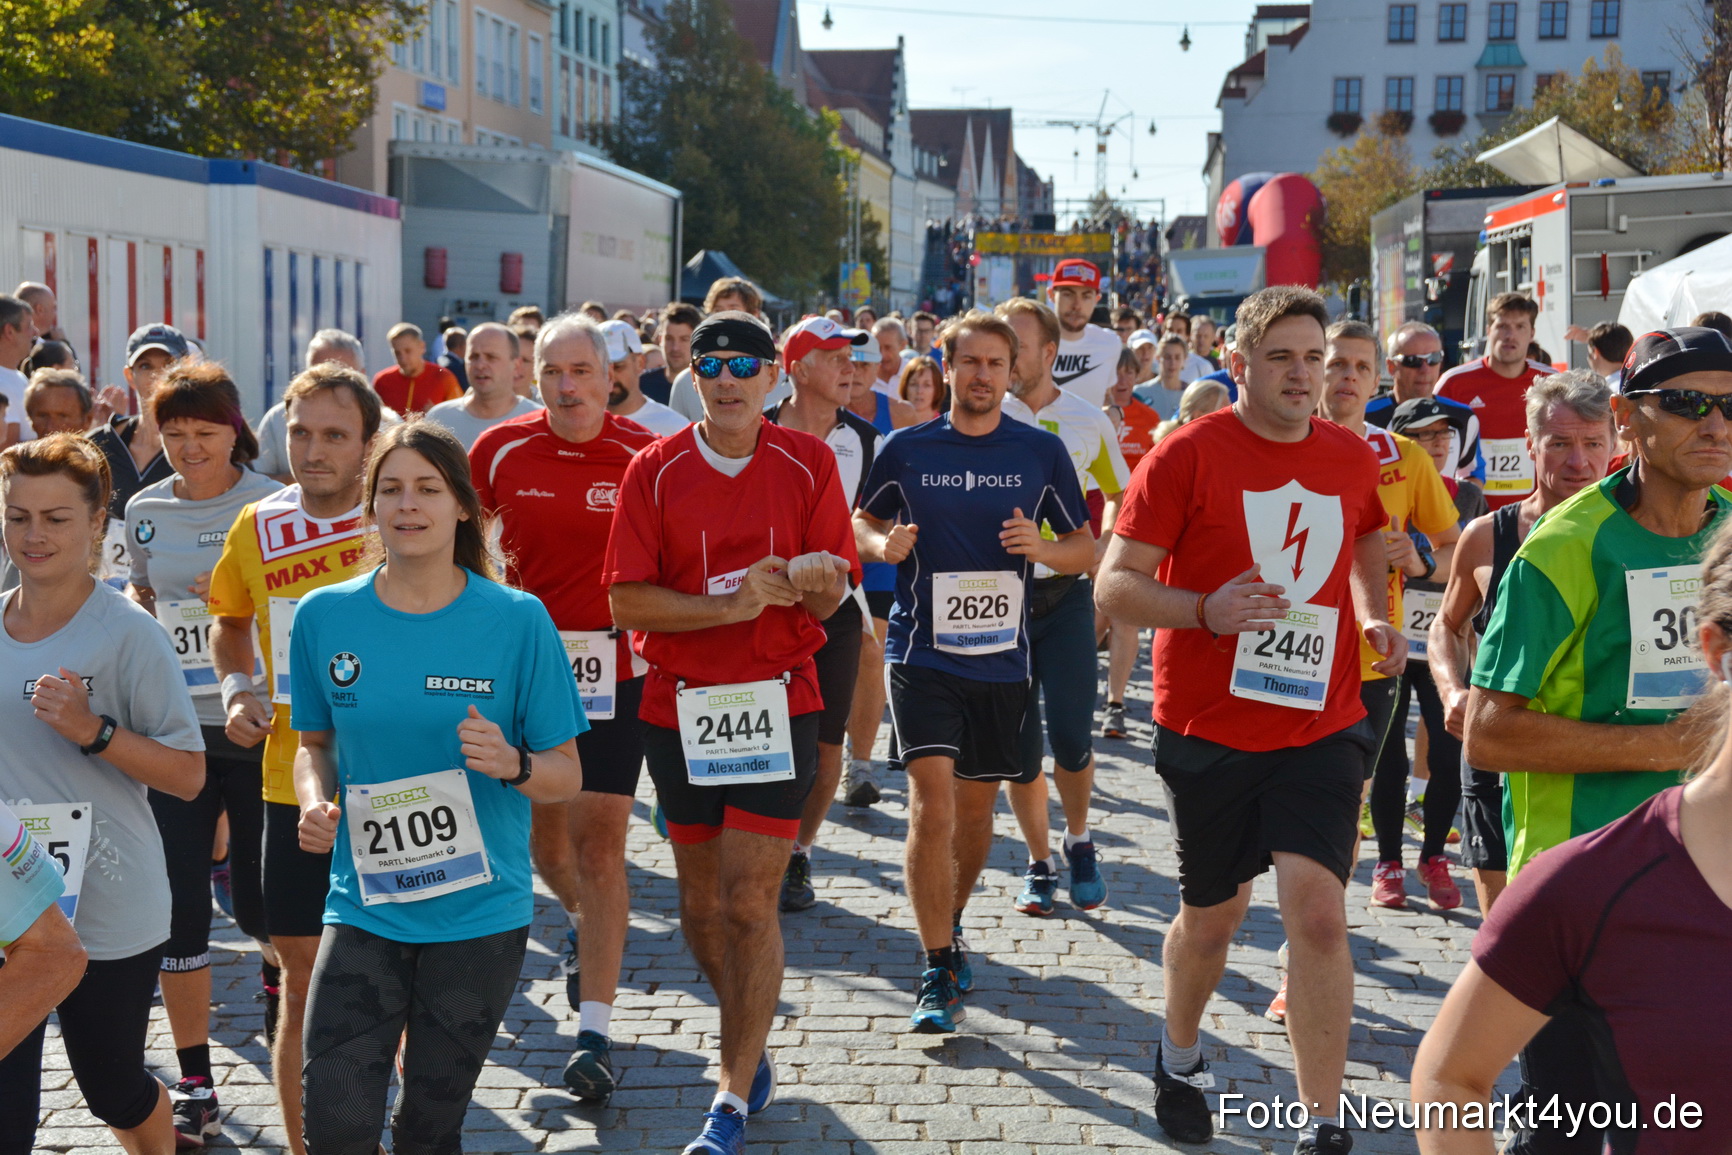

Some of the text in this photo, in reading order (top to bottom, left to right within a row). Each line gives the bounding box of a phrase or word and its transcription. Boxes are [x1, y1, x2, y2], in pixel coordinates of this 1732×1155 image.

[1054, 355, 1091, 371] NIKE
[1489, 455, 1520, 472] 122
[921, 474, 1022, 487] EURO POLES
[264, 555, 331, 591] MAX
[959, 579, 998, 588] BOCK
[947, 594, 1009, 620] 2626
[1286, 610, 1319, 625] OCK
[957, 635, 999, 646] Stephan
[1254, 629, 1324, 666] 2449
[1259, 662, 1311, 676] PARTL Neumarkt
[1664, 656, 1692, 665] PARTL
[425, 675, 495, 694] BOCK
[1263, 676, 1310, 697] Thomas
[331, 692, 358, 702] PARTL
[708, 692, 755, 706] BOCK
[696, 709, 773, 745] 2444
[707, 759, 771, 774] Alexander
[371, 786, 430, 809] BOCK
[363, 805, 458, 855] 2109
[378, 850, 444, 867] PARTL Neumarkt
[395, 869, 447, 889] Karina
